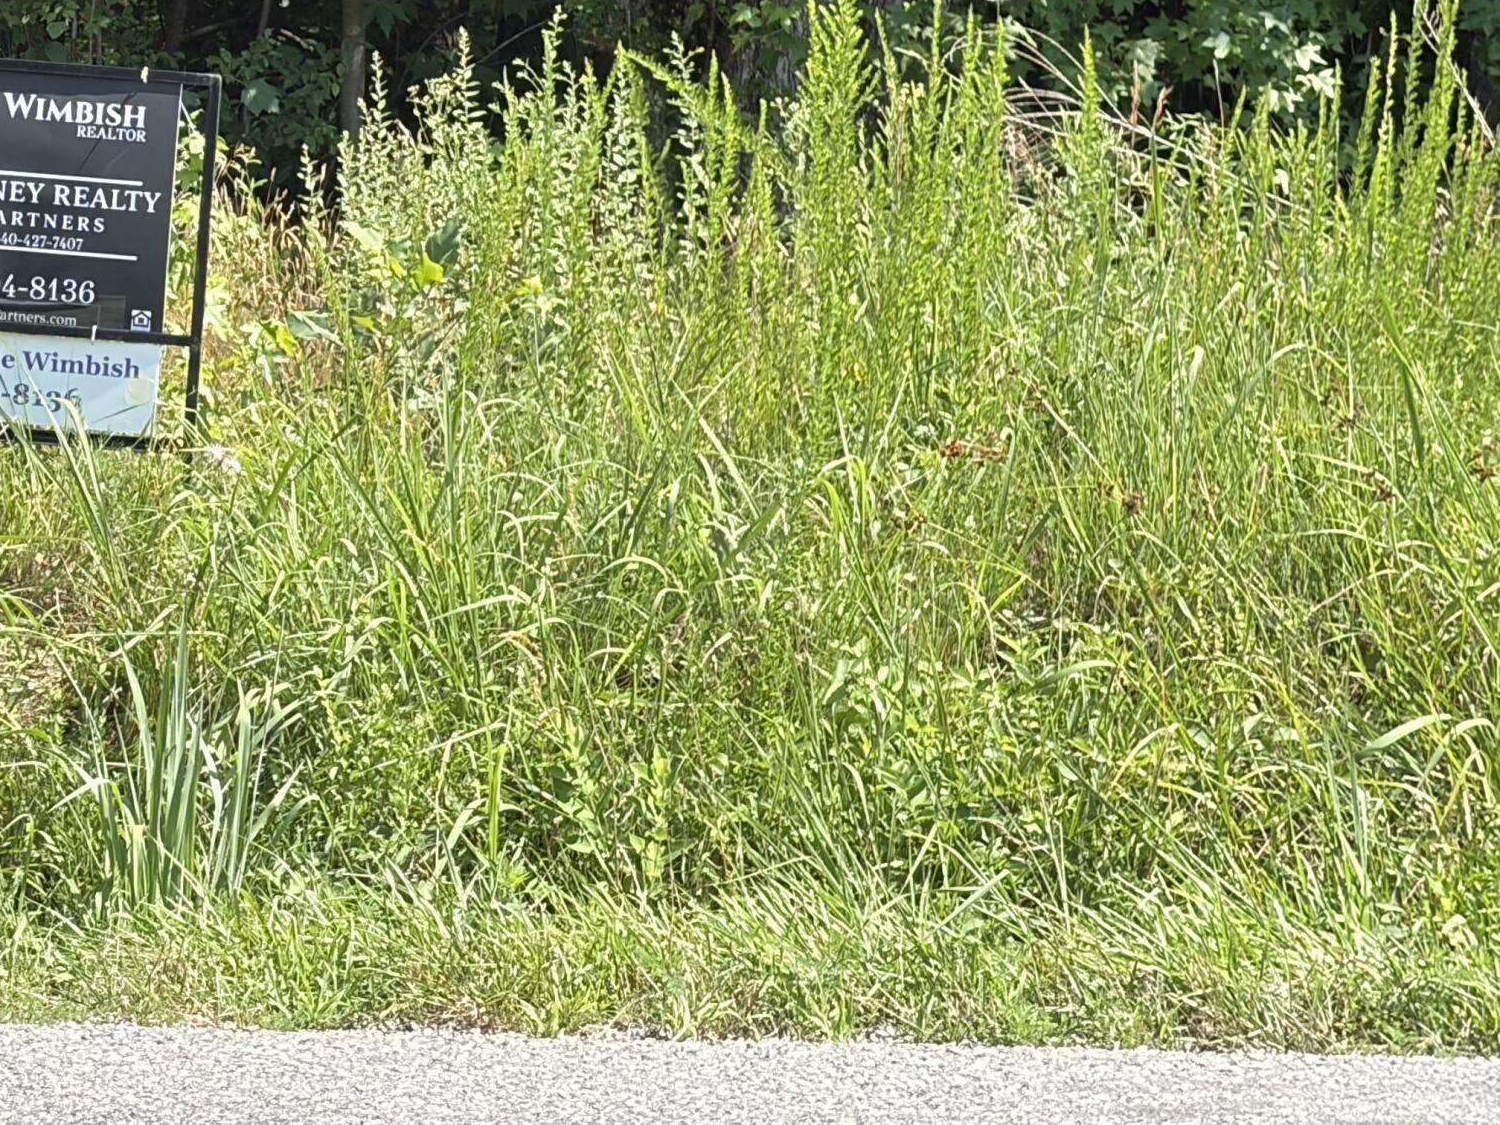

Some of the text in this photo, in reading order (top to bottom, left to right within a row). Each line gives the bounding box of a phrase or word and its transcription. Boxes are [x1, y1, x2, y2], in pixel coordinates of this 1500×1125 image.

[2, 92, 147, 129] WIMBISH
[76, 125, 147, 143] REALTOR
[53, 184, 162, 214] REALTY
[22, 350, 140, 379] Wimbish
